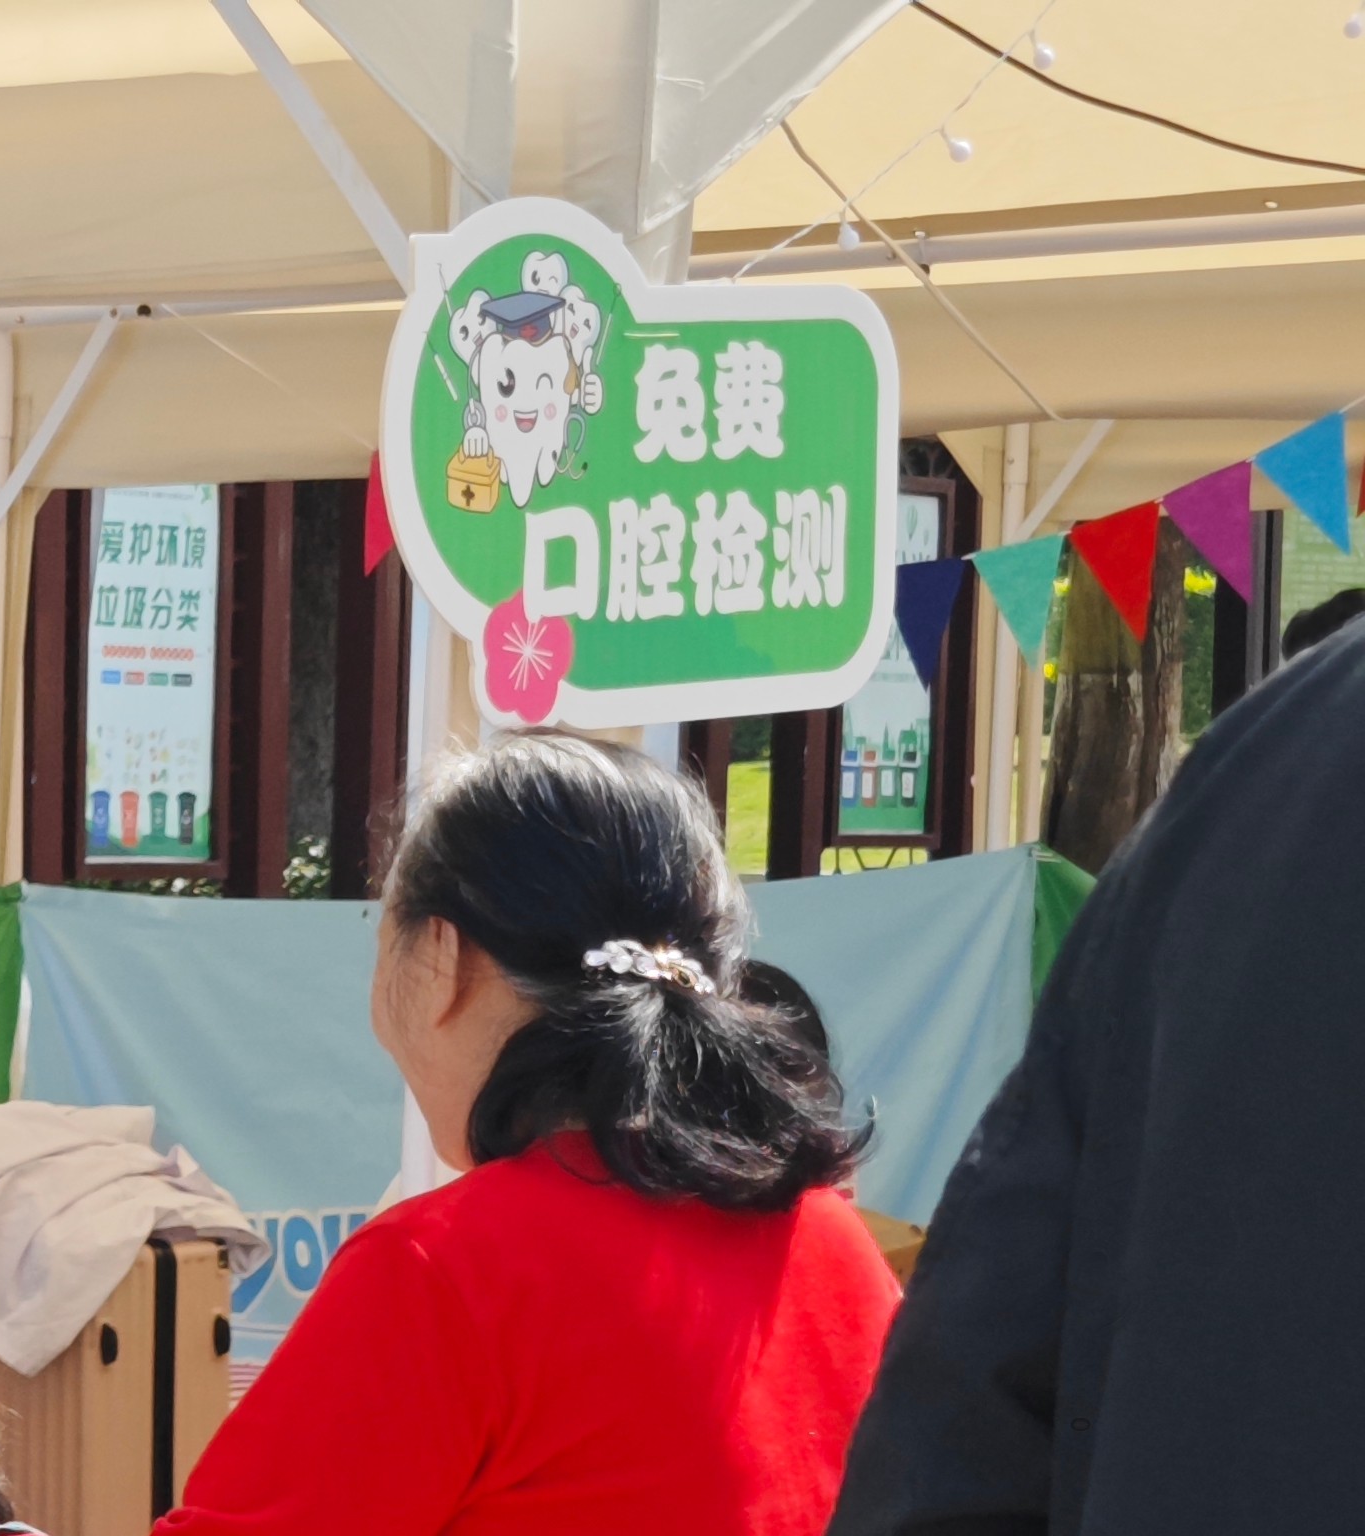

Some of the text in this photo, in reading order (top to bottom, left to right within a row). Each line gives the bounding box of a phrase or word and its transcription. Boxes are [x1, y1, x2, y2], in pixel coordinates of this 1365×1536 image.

[632, 341, 785, 464] 免费
[98, 521, 207, 570] 爱护环境
[523, 485, 847, 623] 口腔检测
[94, 585, 202, 632] 垃圾分类
